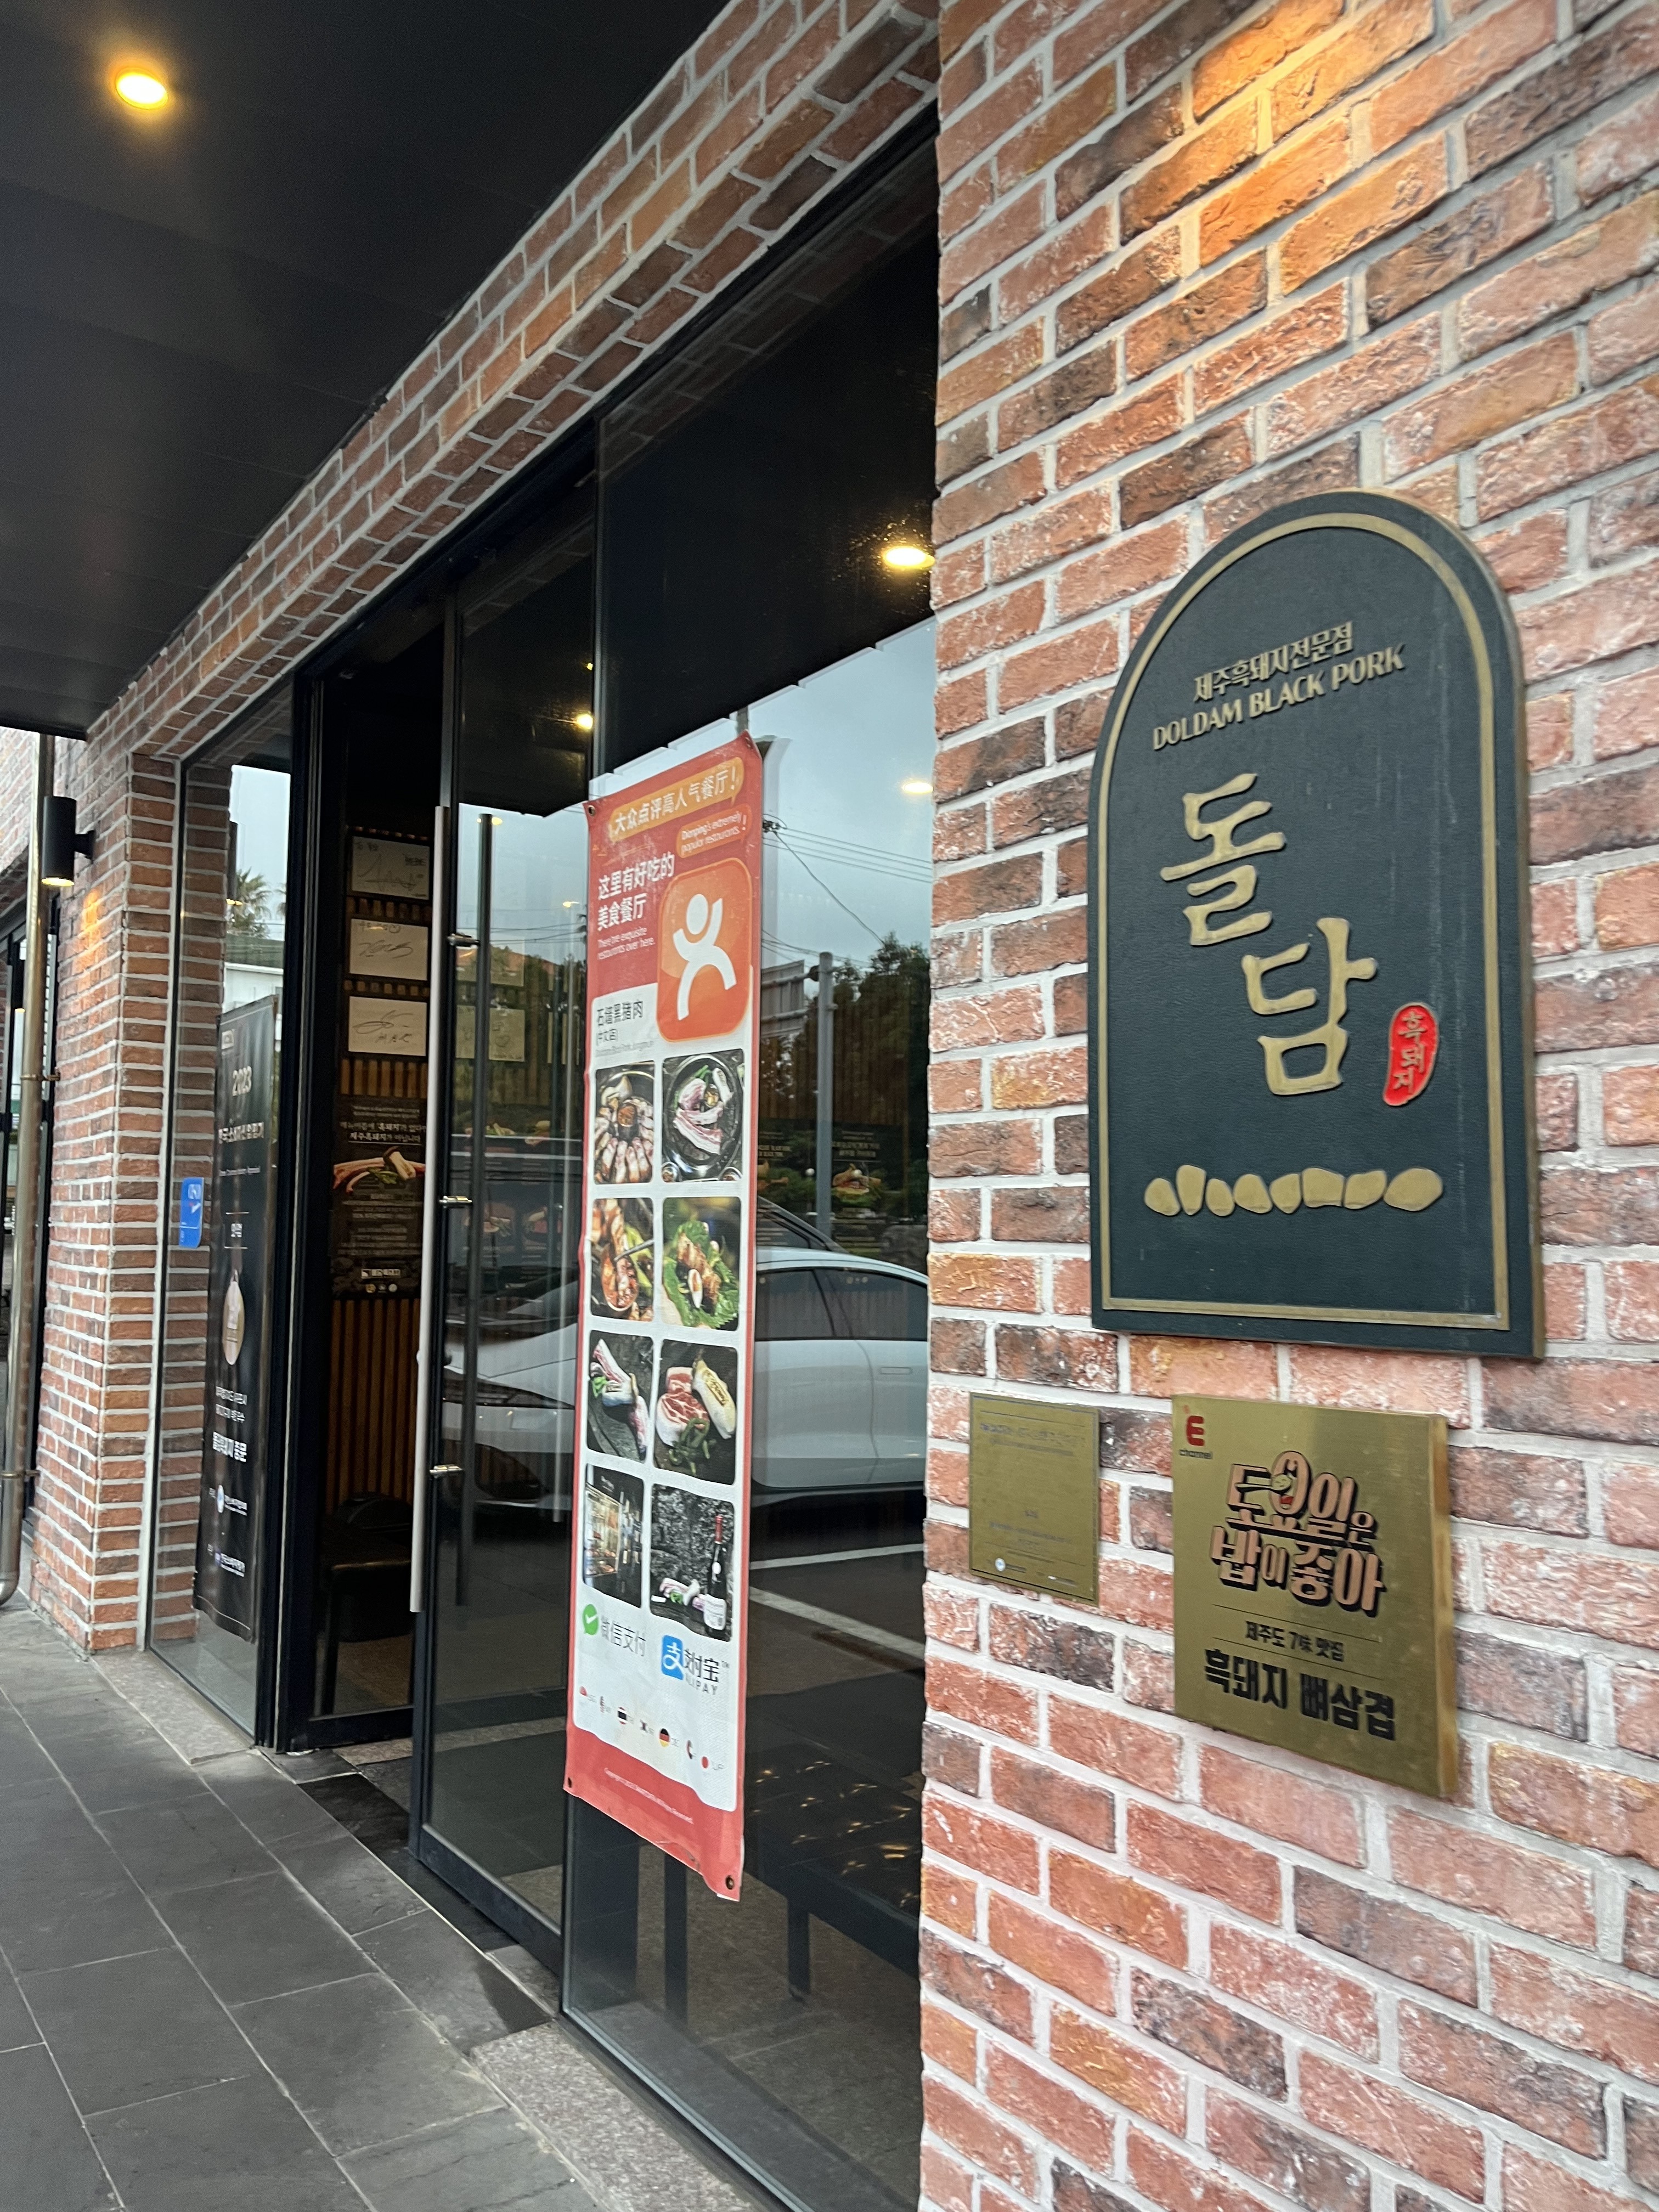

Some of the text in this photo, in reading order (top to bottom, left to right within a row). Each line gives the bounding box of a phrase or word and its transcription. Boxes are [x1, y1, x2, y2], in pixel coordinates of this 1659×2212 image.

[1153, 642, 1406, 751] DOLDAM BLACK PORK
[1194, 620, 1353, 703] 제주흑돼지전문점
[597, 893, 648, 932] 美食餐厅
[598, 851, 675, 901] 这里有好吃的
[1160, 773, 1379, 1096] 돌담
[1393, 1011, 1427, 1096] 흑돼지
[1187, 1415, 1205, 1447] E
[1225, 1450, 1379, 1553] 토요일은
[1210, 1525, 1388, 1618] 밥이 좋아
[601, 1615, 646, 1657] 微信支付
[1245, 1620, 1286, 1648] 제주도
[1315, 1636, 1344, 1662] 맛집
[1204, 1647, 1396, 1742] 흑돼지 뼈삼겹
